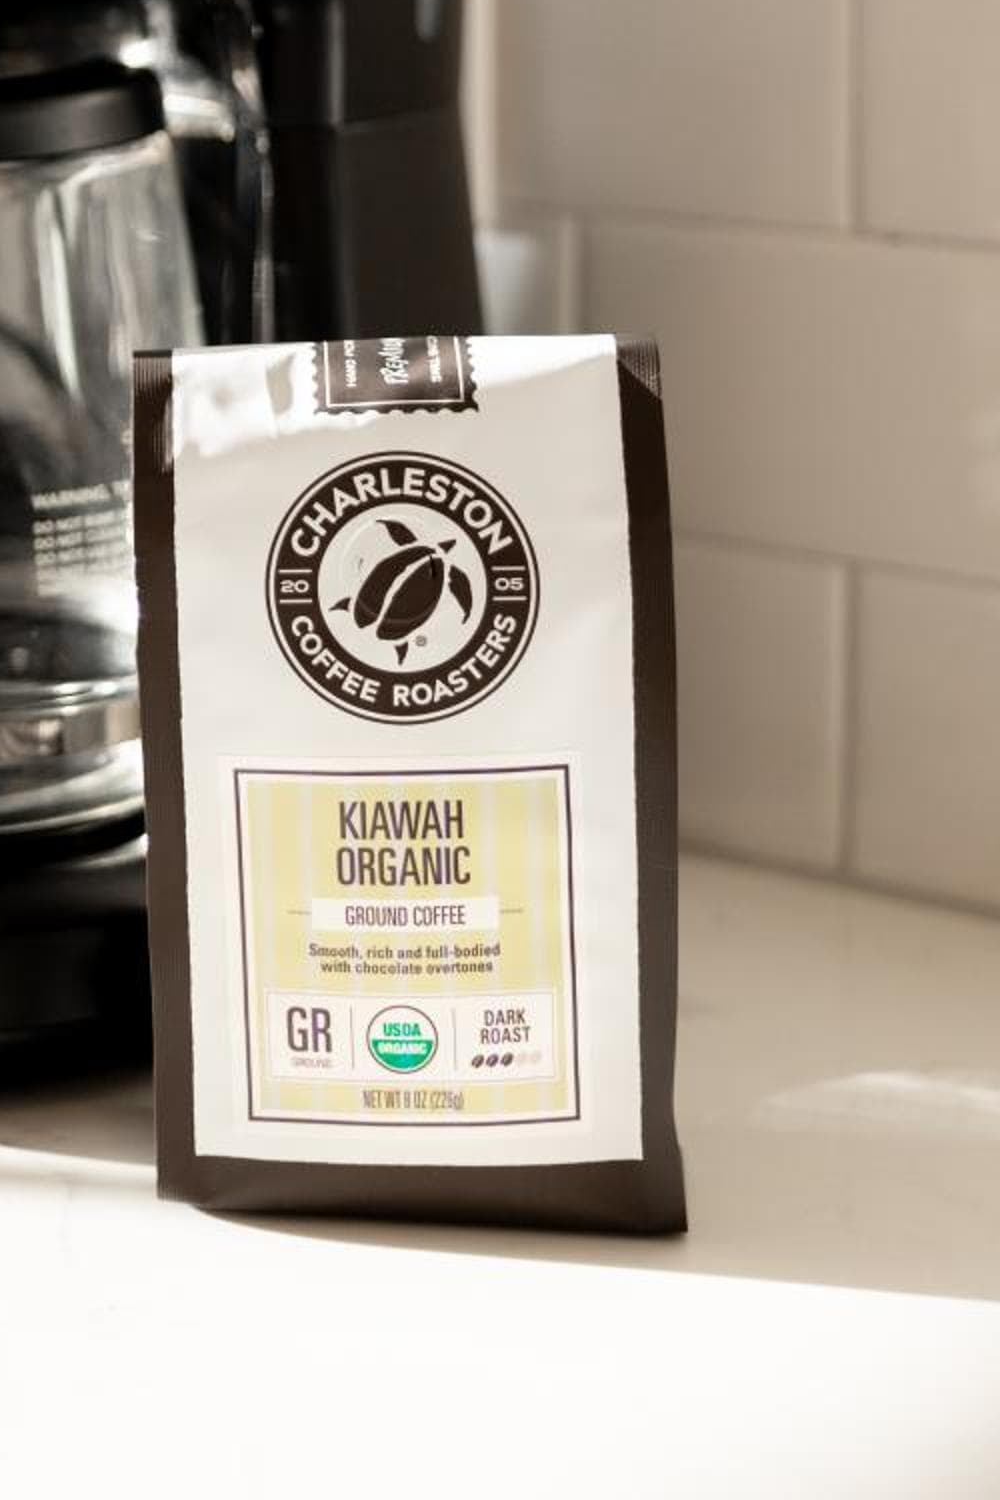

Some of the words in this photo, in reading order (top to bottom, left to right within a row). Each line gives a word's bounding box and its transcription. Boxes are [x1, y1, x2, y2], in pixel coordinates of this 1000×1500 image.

[290, 467, 513, 557] CHARLESTON
[280, 579, 309, 593] 20
[495, 577, 523, 591] 05
[291, 614, 381, 704] COFFEE
[393, 613, 517, 708] ROASTERS
[338, 799, 464, 840] KIAWAH
[337, 846, 471, 886] ORGANIC
[345, 905, 408, 927] GROUND
[413, 904, 467, 927] COFFEE
[308, 943, 363, 960] Smooth,
[366, 945, 393, 959] rich
[397, 946, 422, 959] and
[426, 941, 501, 959] full-bodied
[321, 960, 351, 974] with
[355, 961, 422, 975] chocolate
[426, 960, 493, 975] overtones
[484, 1009, 526, 1026] DARK
[286, 1006, 332, 1053] GR
[383, 1022, 422, 1037] USDA
[480, 1026, 531, 1045] ROAST
[376, 1040, 427, 1054] ORGANIC
[363, 1090, 382, 1108] NET
[382, 1090, 400, 1108] WT
[413, 1090, 426, 1108] OZ
